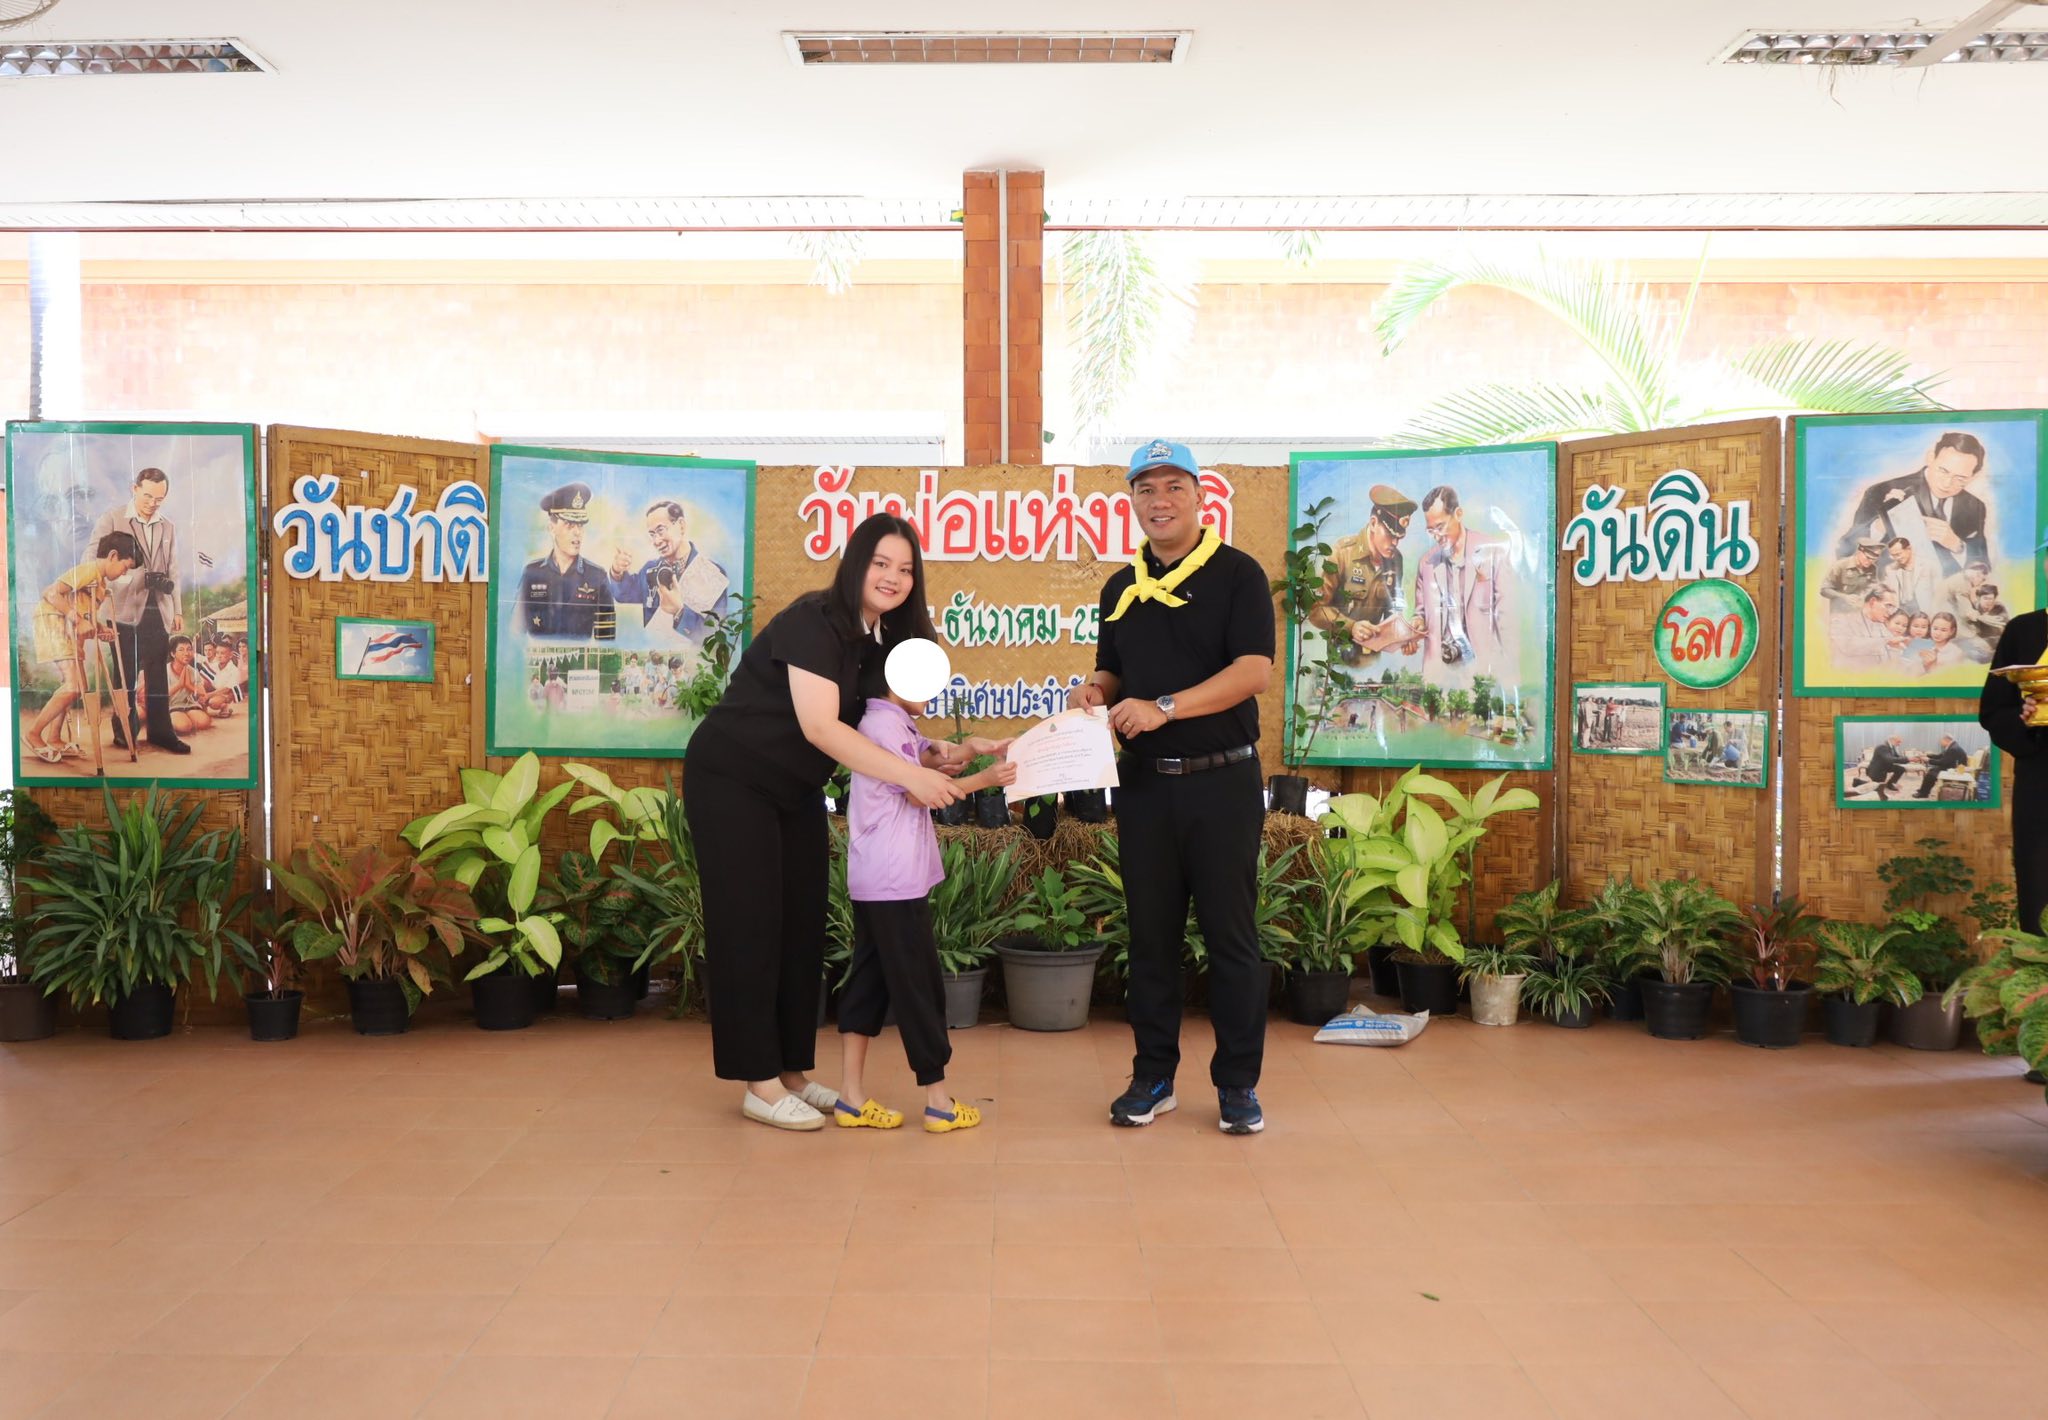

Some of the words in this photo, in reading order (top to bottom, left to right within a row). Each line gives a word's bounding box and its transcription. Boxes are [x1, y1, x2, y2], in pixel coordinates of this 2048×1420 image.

[280, 478, 487, 578] วันชาติ
[1564, 472, 1752, 580] วันดิน
[943, 590, 1058, 643] ธันวาคม
[1663, 604, 1744, 664] โลก
